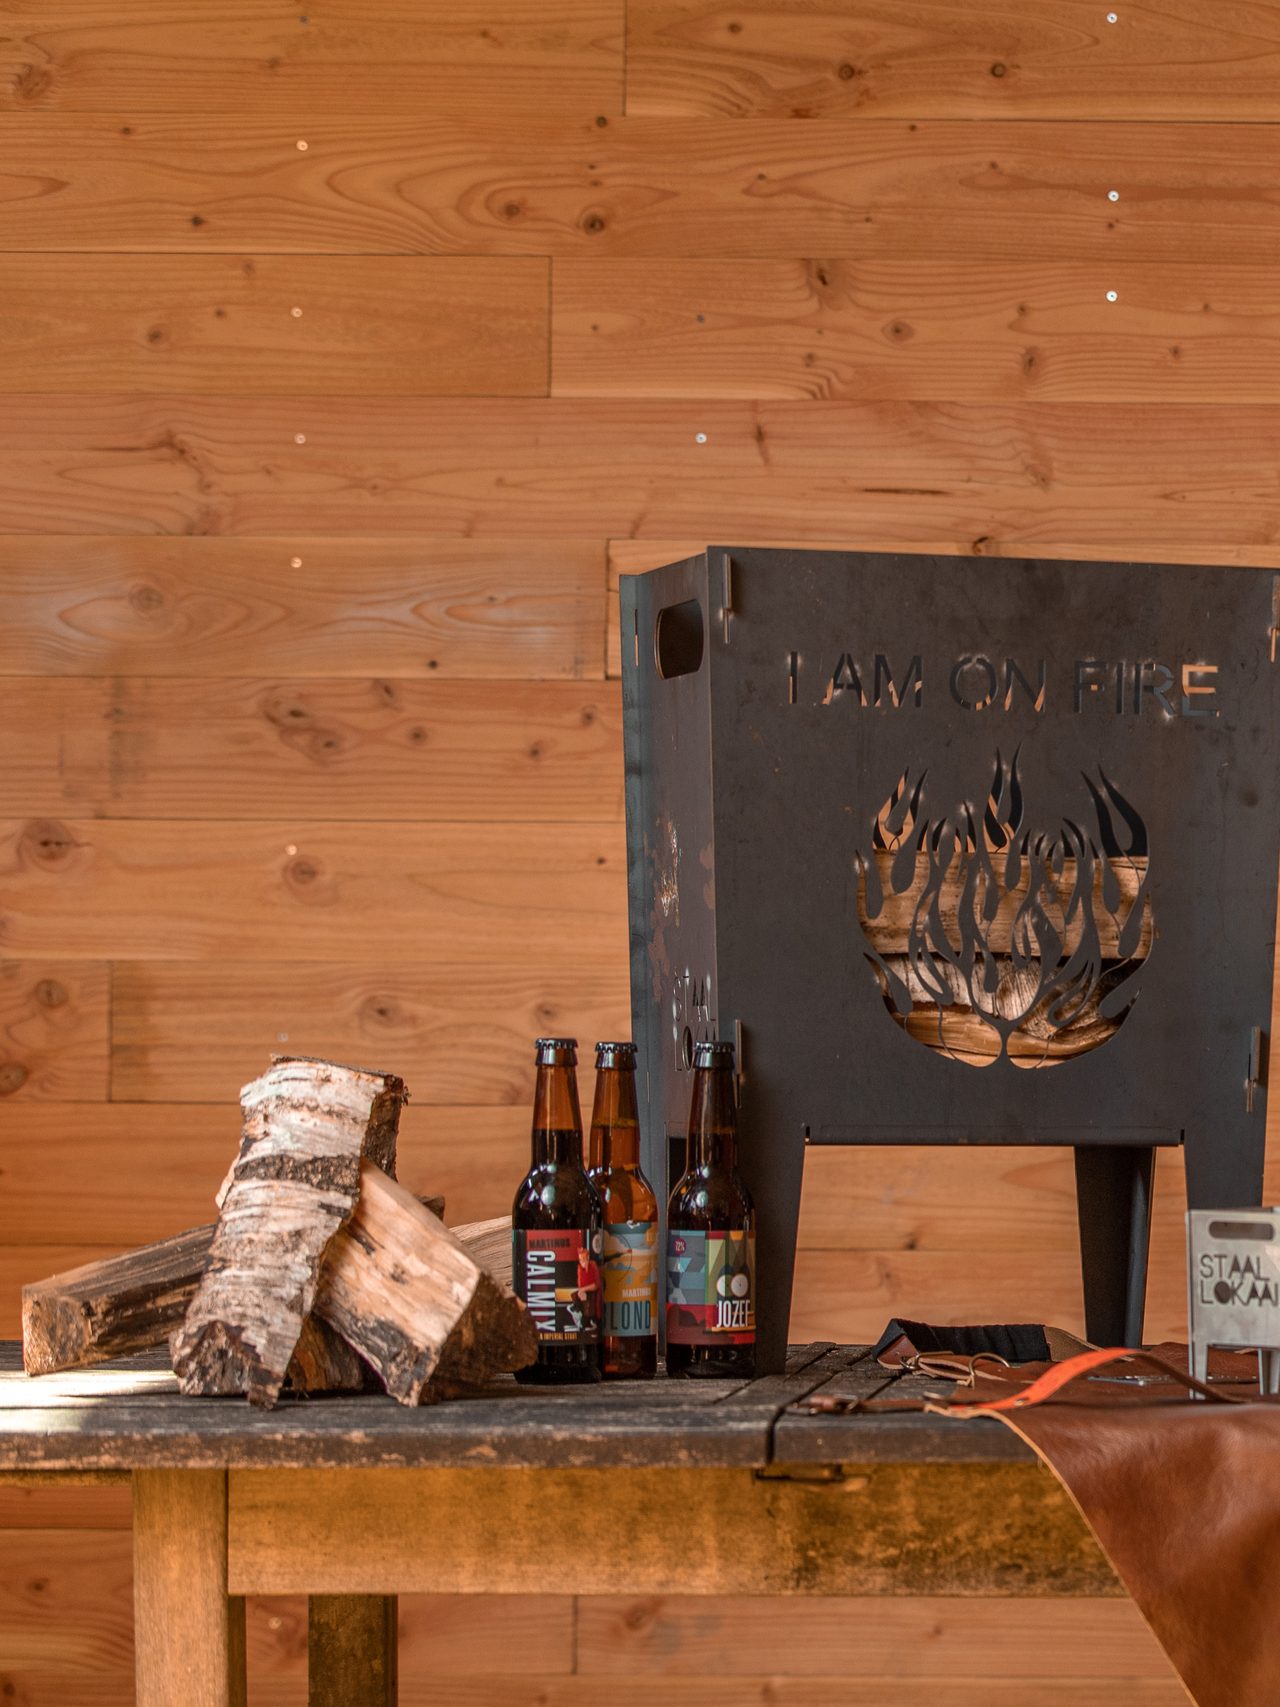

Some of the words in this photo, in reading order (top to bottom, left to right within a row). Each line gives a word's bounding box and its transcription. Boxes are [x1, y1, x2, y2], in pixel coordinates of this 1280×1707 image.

[788, 651, 799, 705] I
[823, 652, 923, 707] AM
[949, 656, 1046, 713] ON
[1073, 660, 1221, 718] FIRE
[1200, 1254, 1271, 1281] STAAL
[527, 1250, 556, 1331] CALMIX
[604, 1300, 651, 1331] LOND
[716, 1300, 751, 1329] JOZEF
